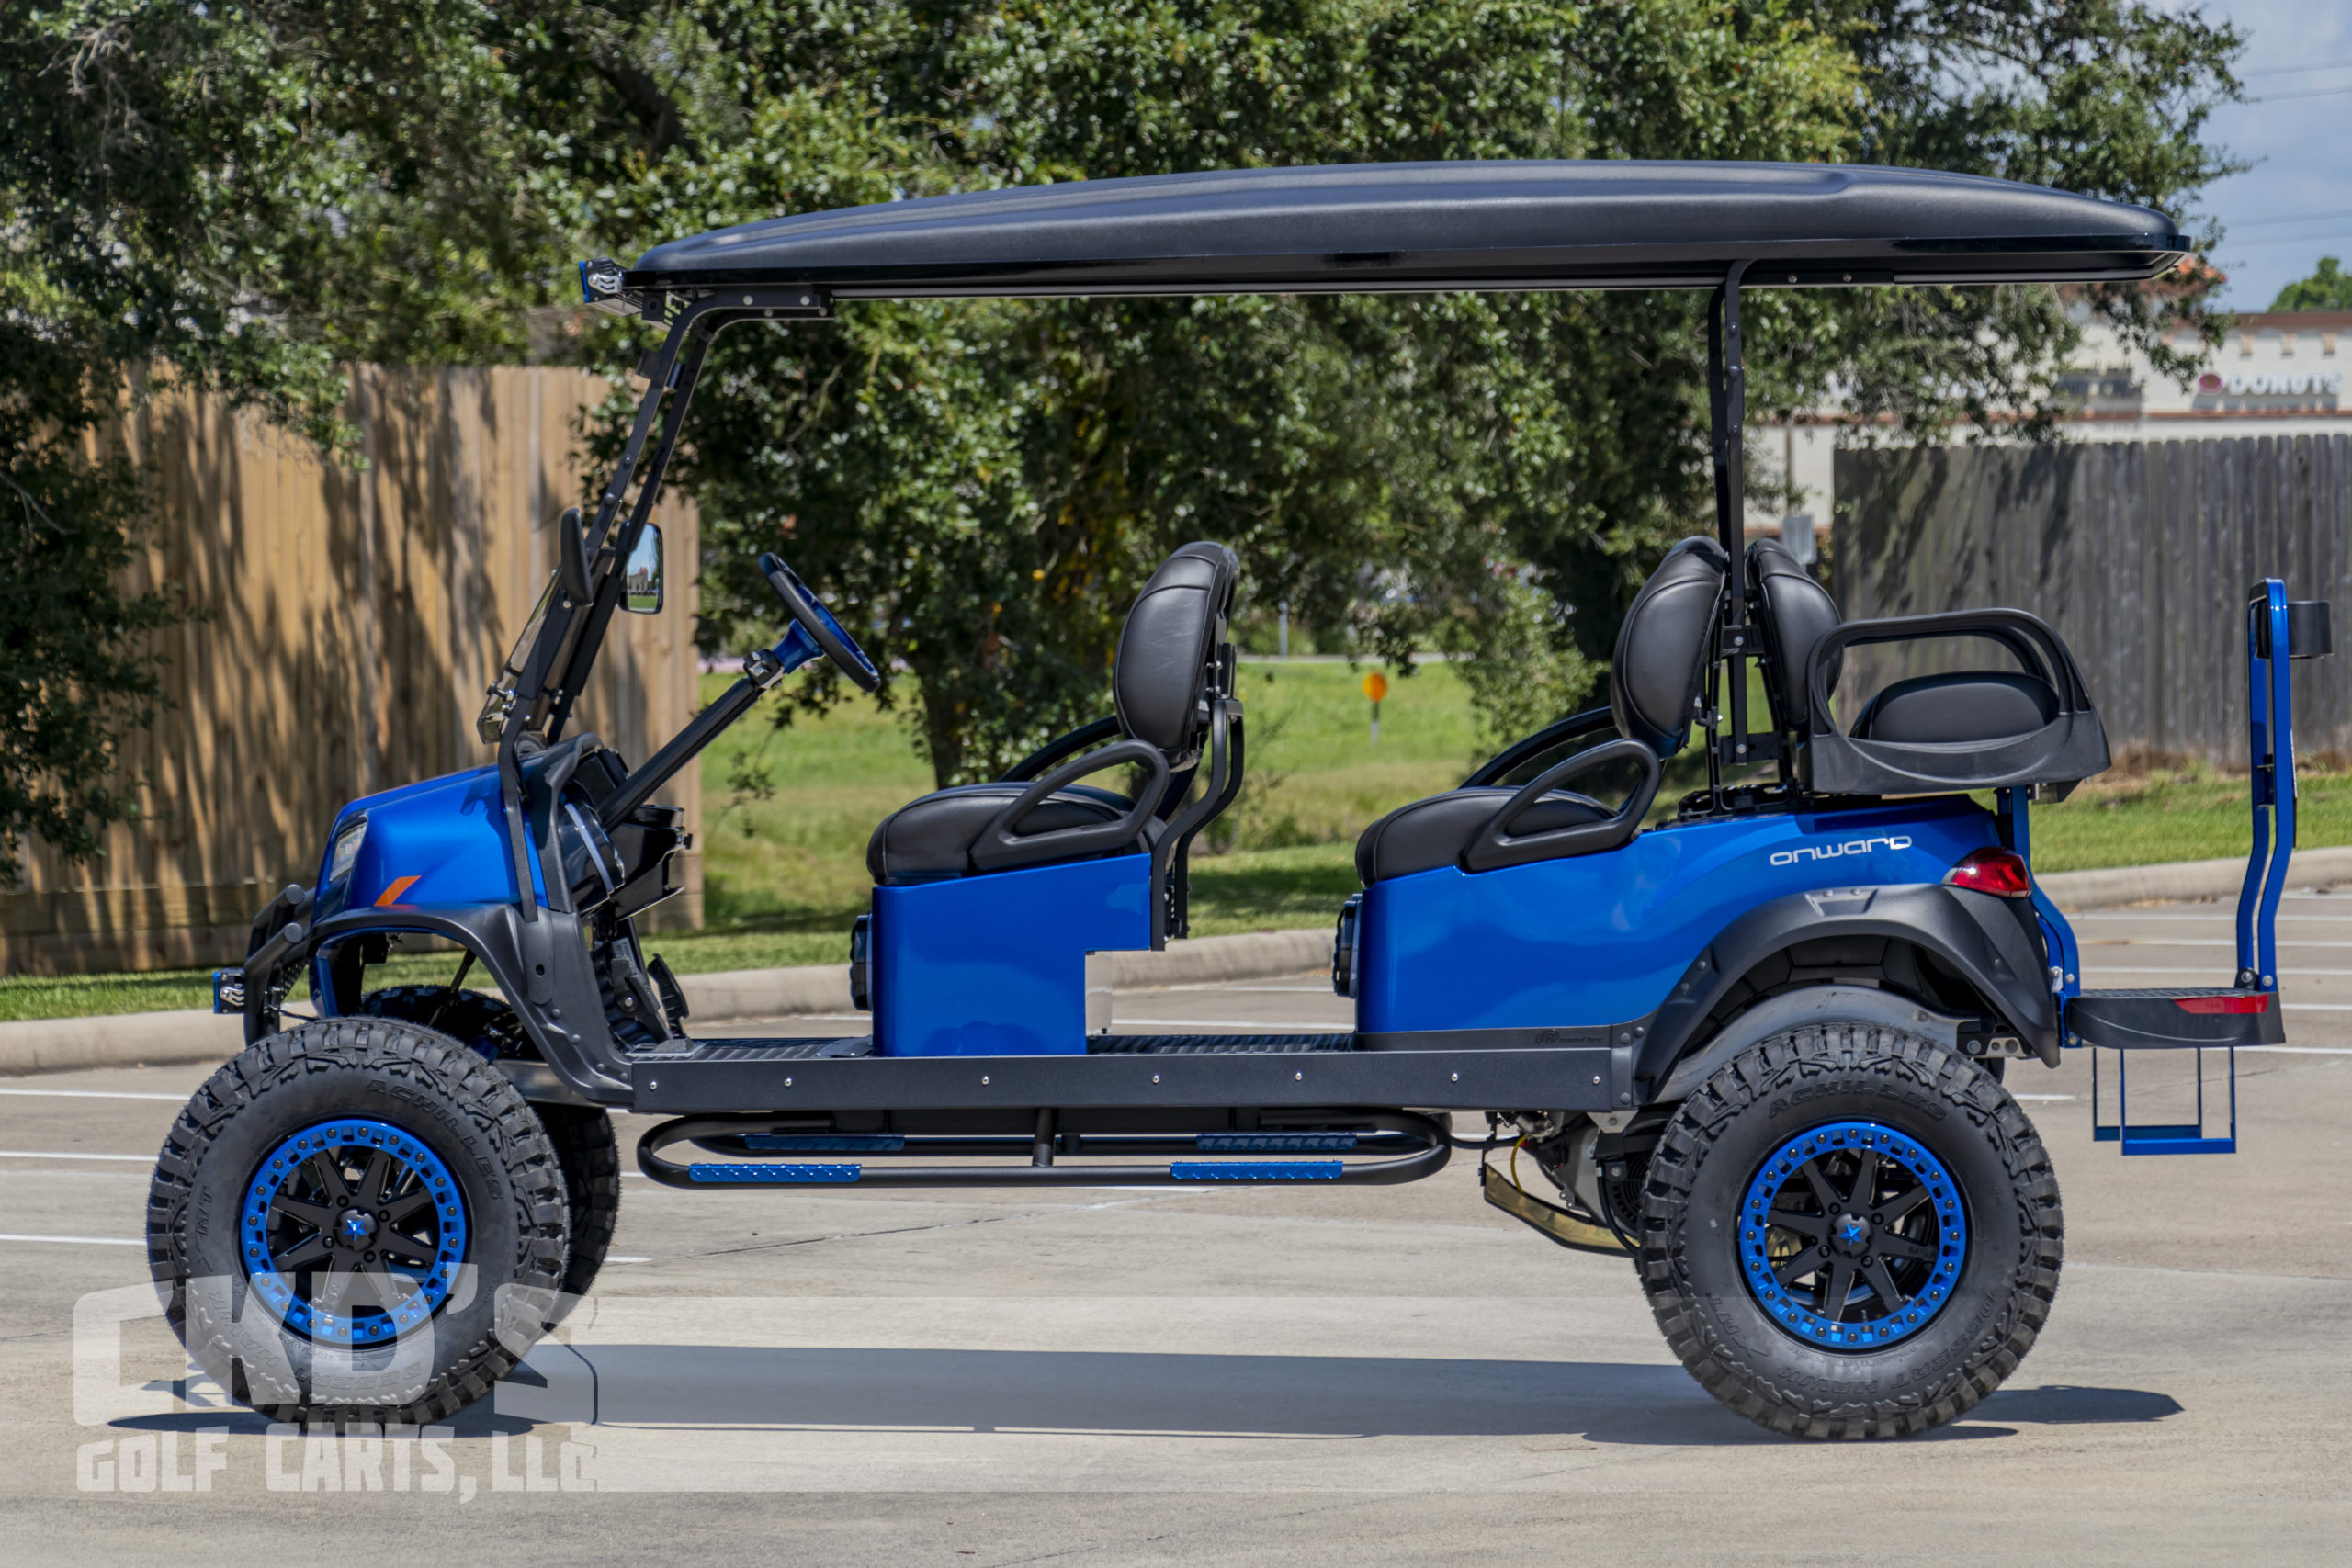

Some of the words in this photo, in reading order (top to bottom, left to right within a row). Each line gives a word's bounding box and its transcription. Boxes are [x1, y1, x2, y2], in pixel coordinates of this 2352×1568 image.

[2228, 372, 2343, 396] DONUTS
[1769, 1079, 1949, 1121] ACHILLES
[365, 1078, 504, 1201] ACHILLES
